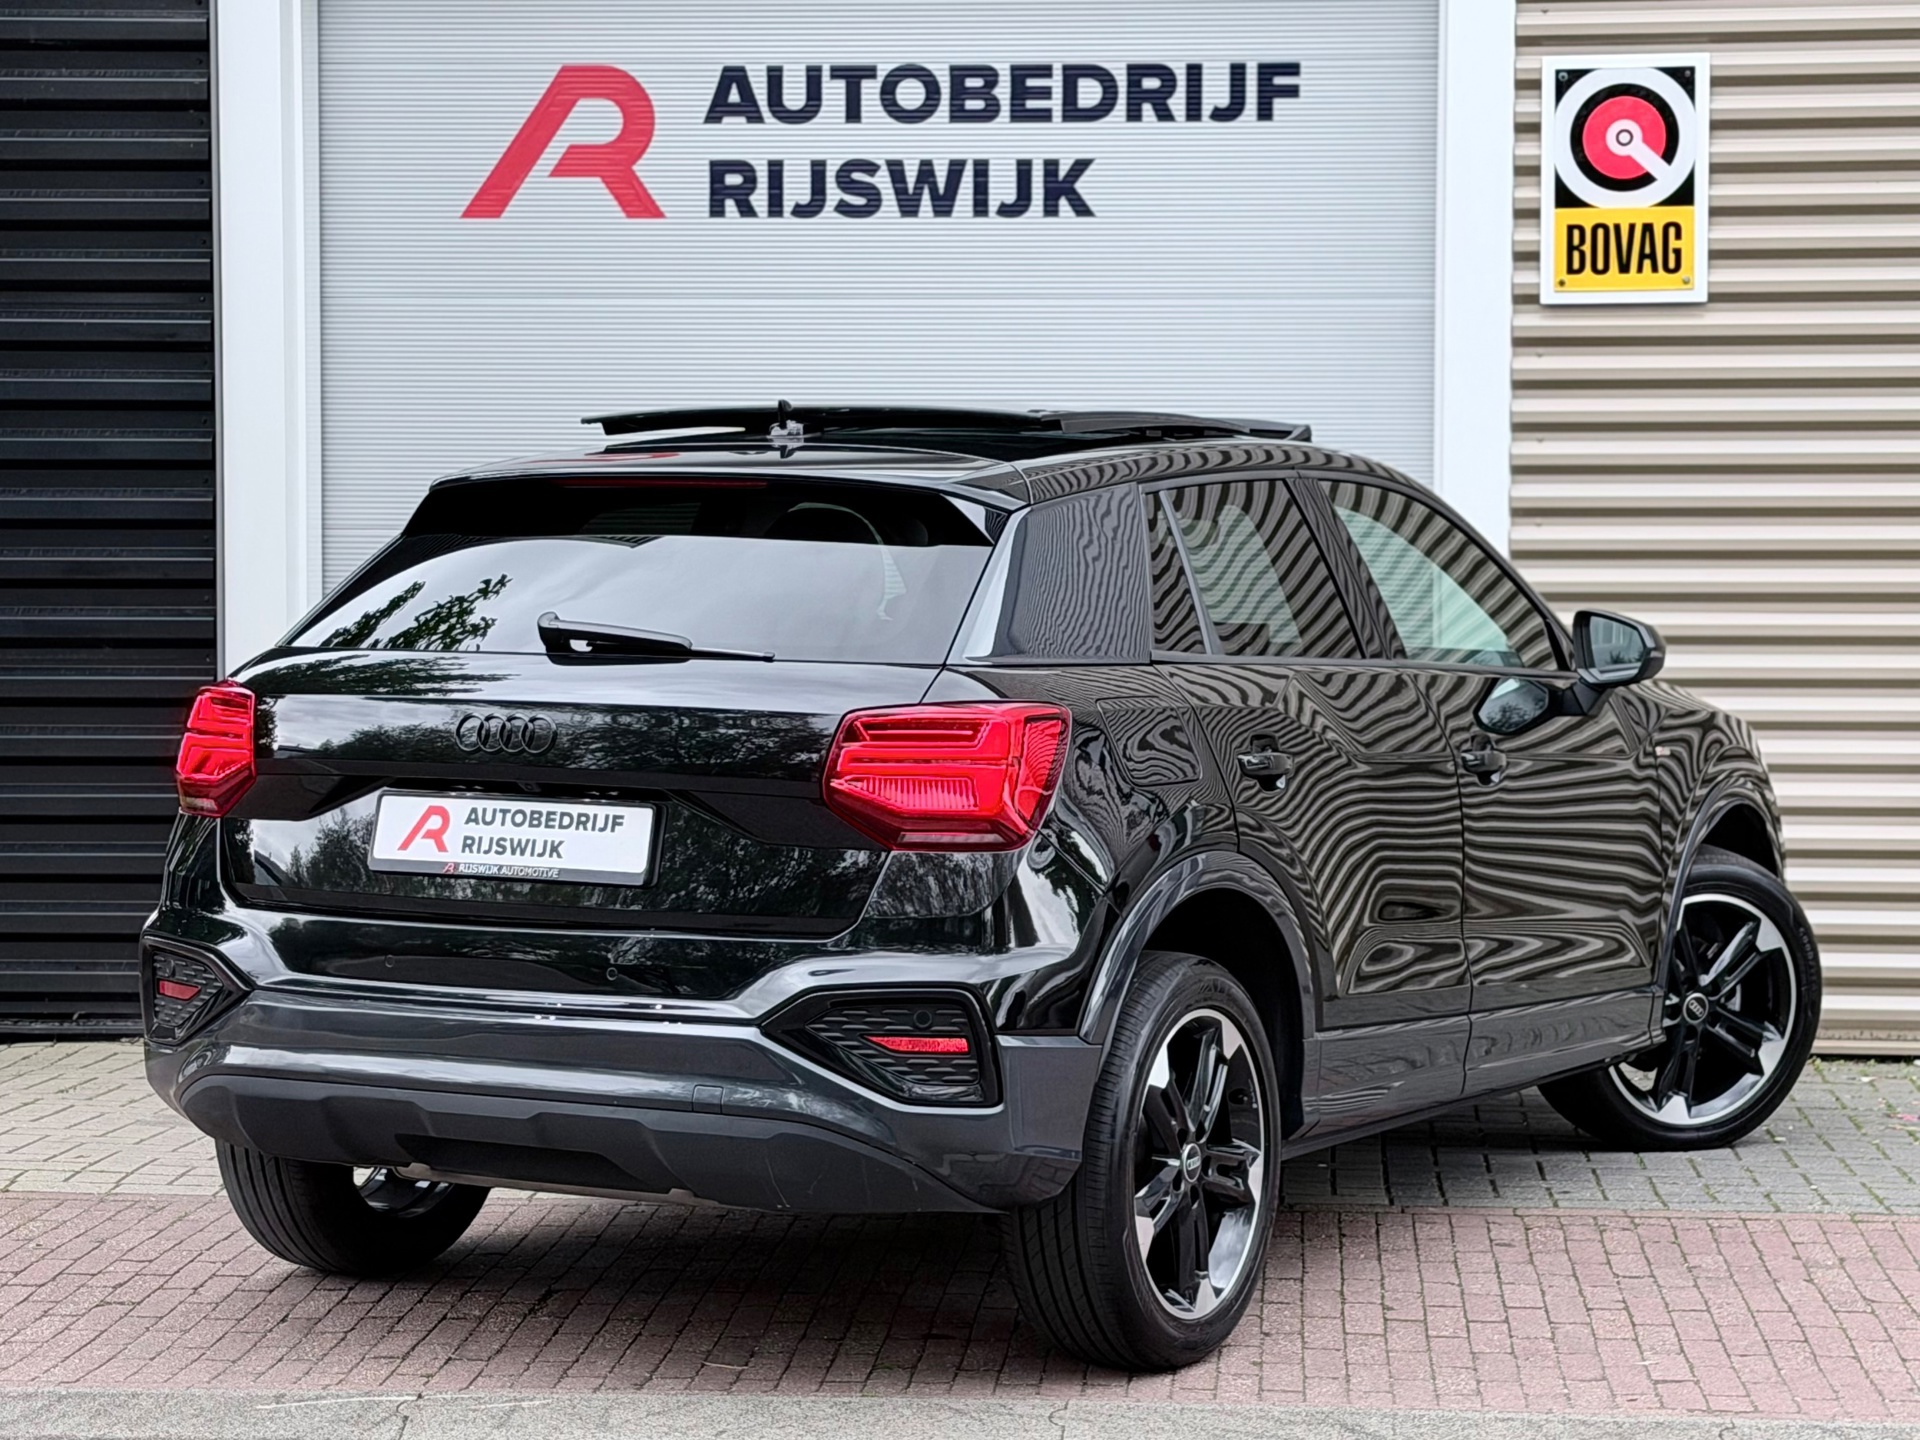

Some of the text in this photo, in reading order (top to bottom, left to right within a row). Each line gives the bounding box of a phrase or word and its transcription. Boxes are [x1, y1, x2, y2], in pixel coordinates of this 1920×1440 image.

[703, 63, 1300, 124] AUTOBEDRIJF
[709, 158, 1096, 218] RIJSWIJK
[1566, 221, 1682, 275] BOVAG
[464, 807, 624, 833] AUTOBEDRIJF
[461, 835, 564, 858] RIJSWIJK
[458, 864, 499, 875] RIJSWIJK
[500, 866, 559, 878] AUTOMOTIVE
